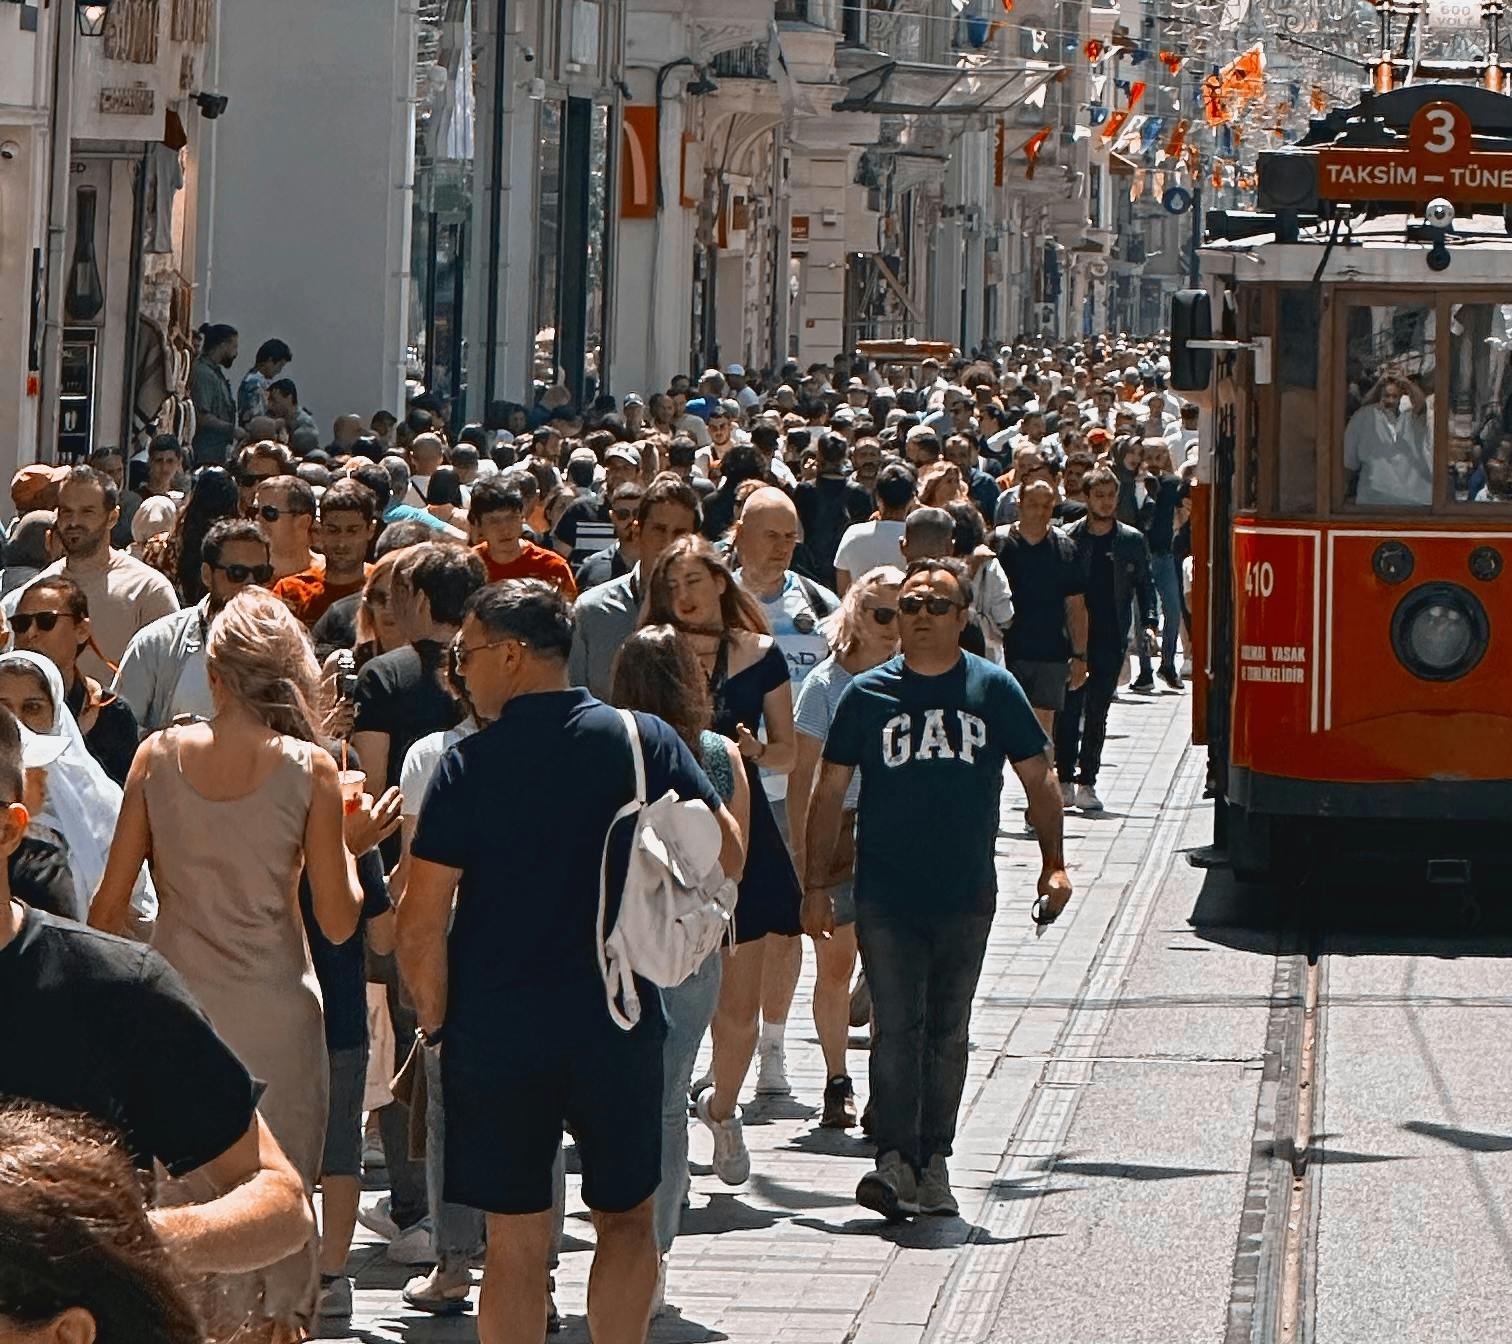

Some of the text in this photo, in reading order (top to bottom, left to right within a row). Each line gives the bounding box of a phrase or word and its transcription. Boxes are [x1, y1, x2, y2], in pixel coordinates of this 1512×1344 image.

[1424, 108, 1456, 154] 3
[1326, 161, 1417, 185] TAKSİM
[1244, 561, 1274, 598] 410
[1271, 646, 1306, 662] YASAK
[882, 708, 987, 768] GAP
